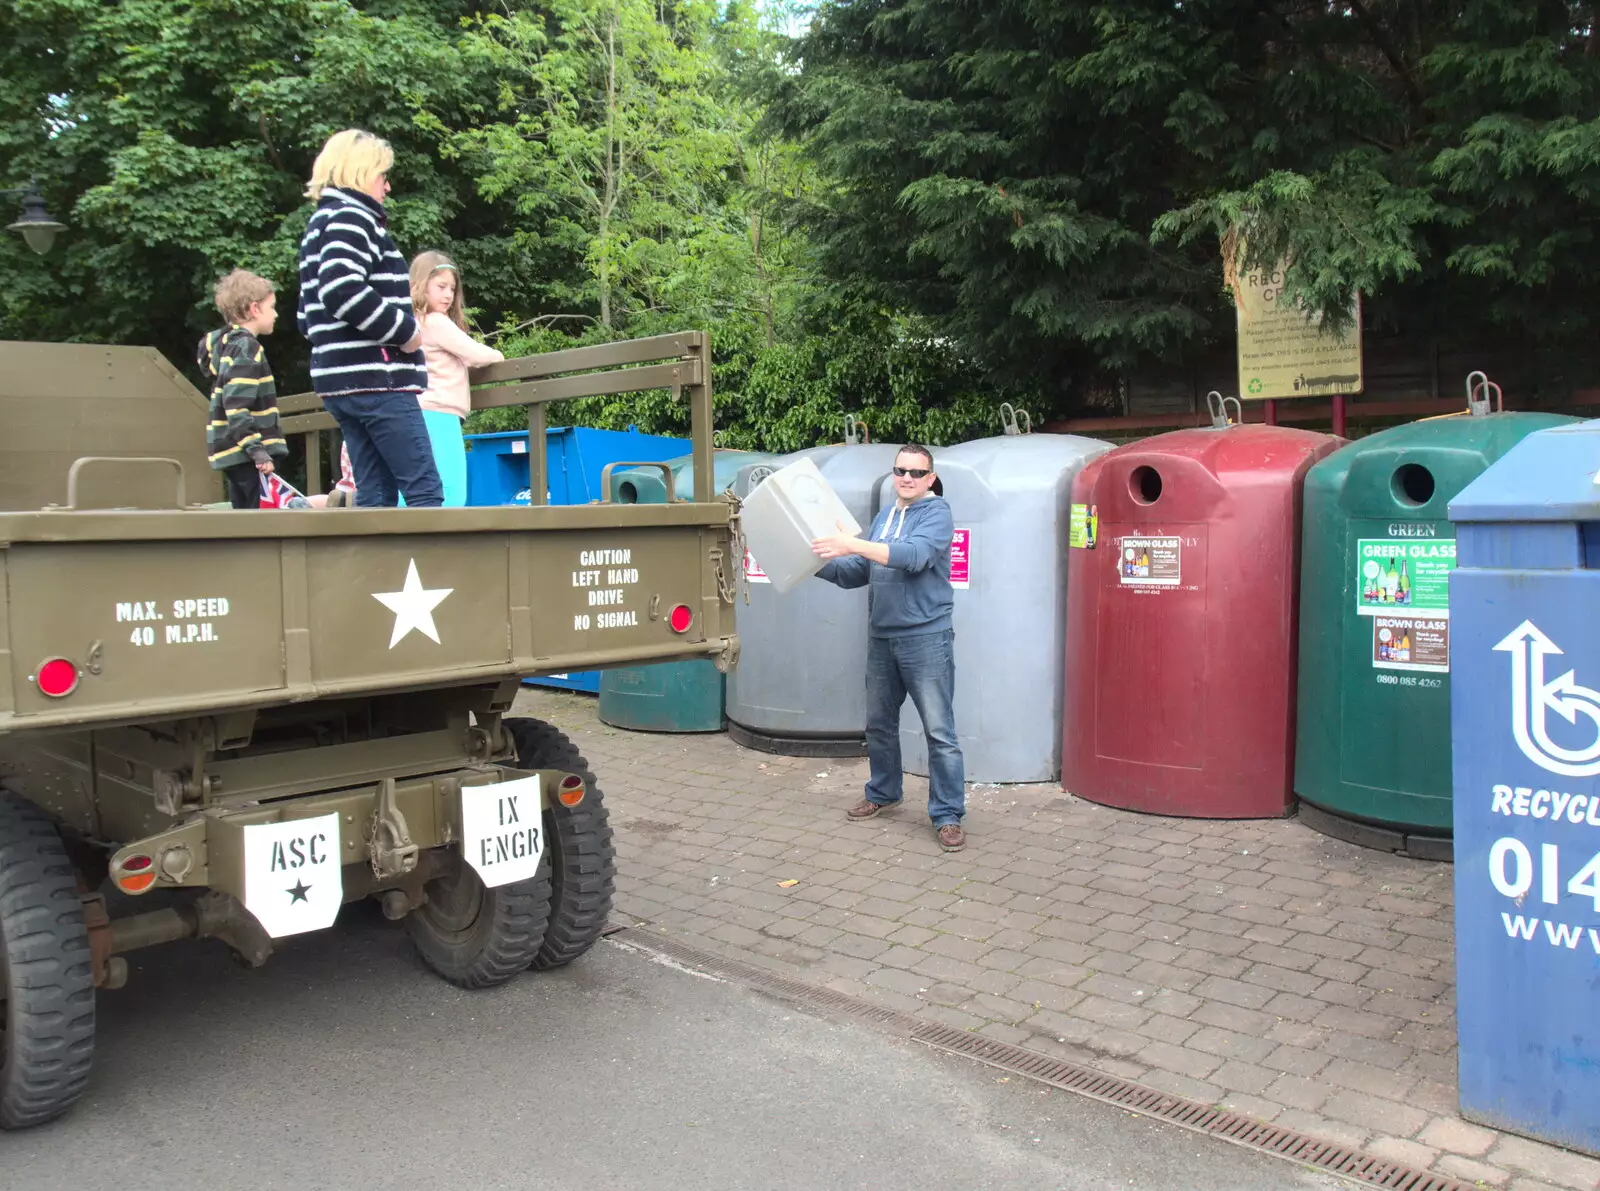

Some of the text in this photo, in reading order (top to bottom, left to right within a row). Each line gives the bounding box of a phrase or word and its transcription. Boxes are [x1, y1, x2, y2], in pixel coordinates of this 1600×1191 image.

[1388, 523, 1436, 537] GREEN
[1123, 540, 1150, 548] BROWN
[1152, 540, 1178, 548] GLASS
[1363, 545, 1457, 558] GREEN GLASS
[580, 549, 631, 566] CAUTION
[572, 568, 639, 587] LEFT HAND
[588, 589, 623, 606] DRIVE
[116, 597, 229, 622] MAX. SPEED
[574, 610, 638, 630] NO SIGNAL
[1376, 618, 1446, 630] BROWN GLASS
[130, 623, 218, 646] 40 M.P.H.
[1376, 674, 1442, 688] 0800 085 4262
[499, 796, 519, 826] IX
[270, 833, 326, 872] ASC
[480, 827, 539, 867] ENGR
